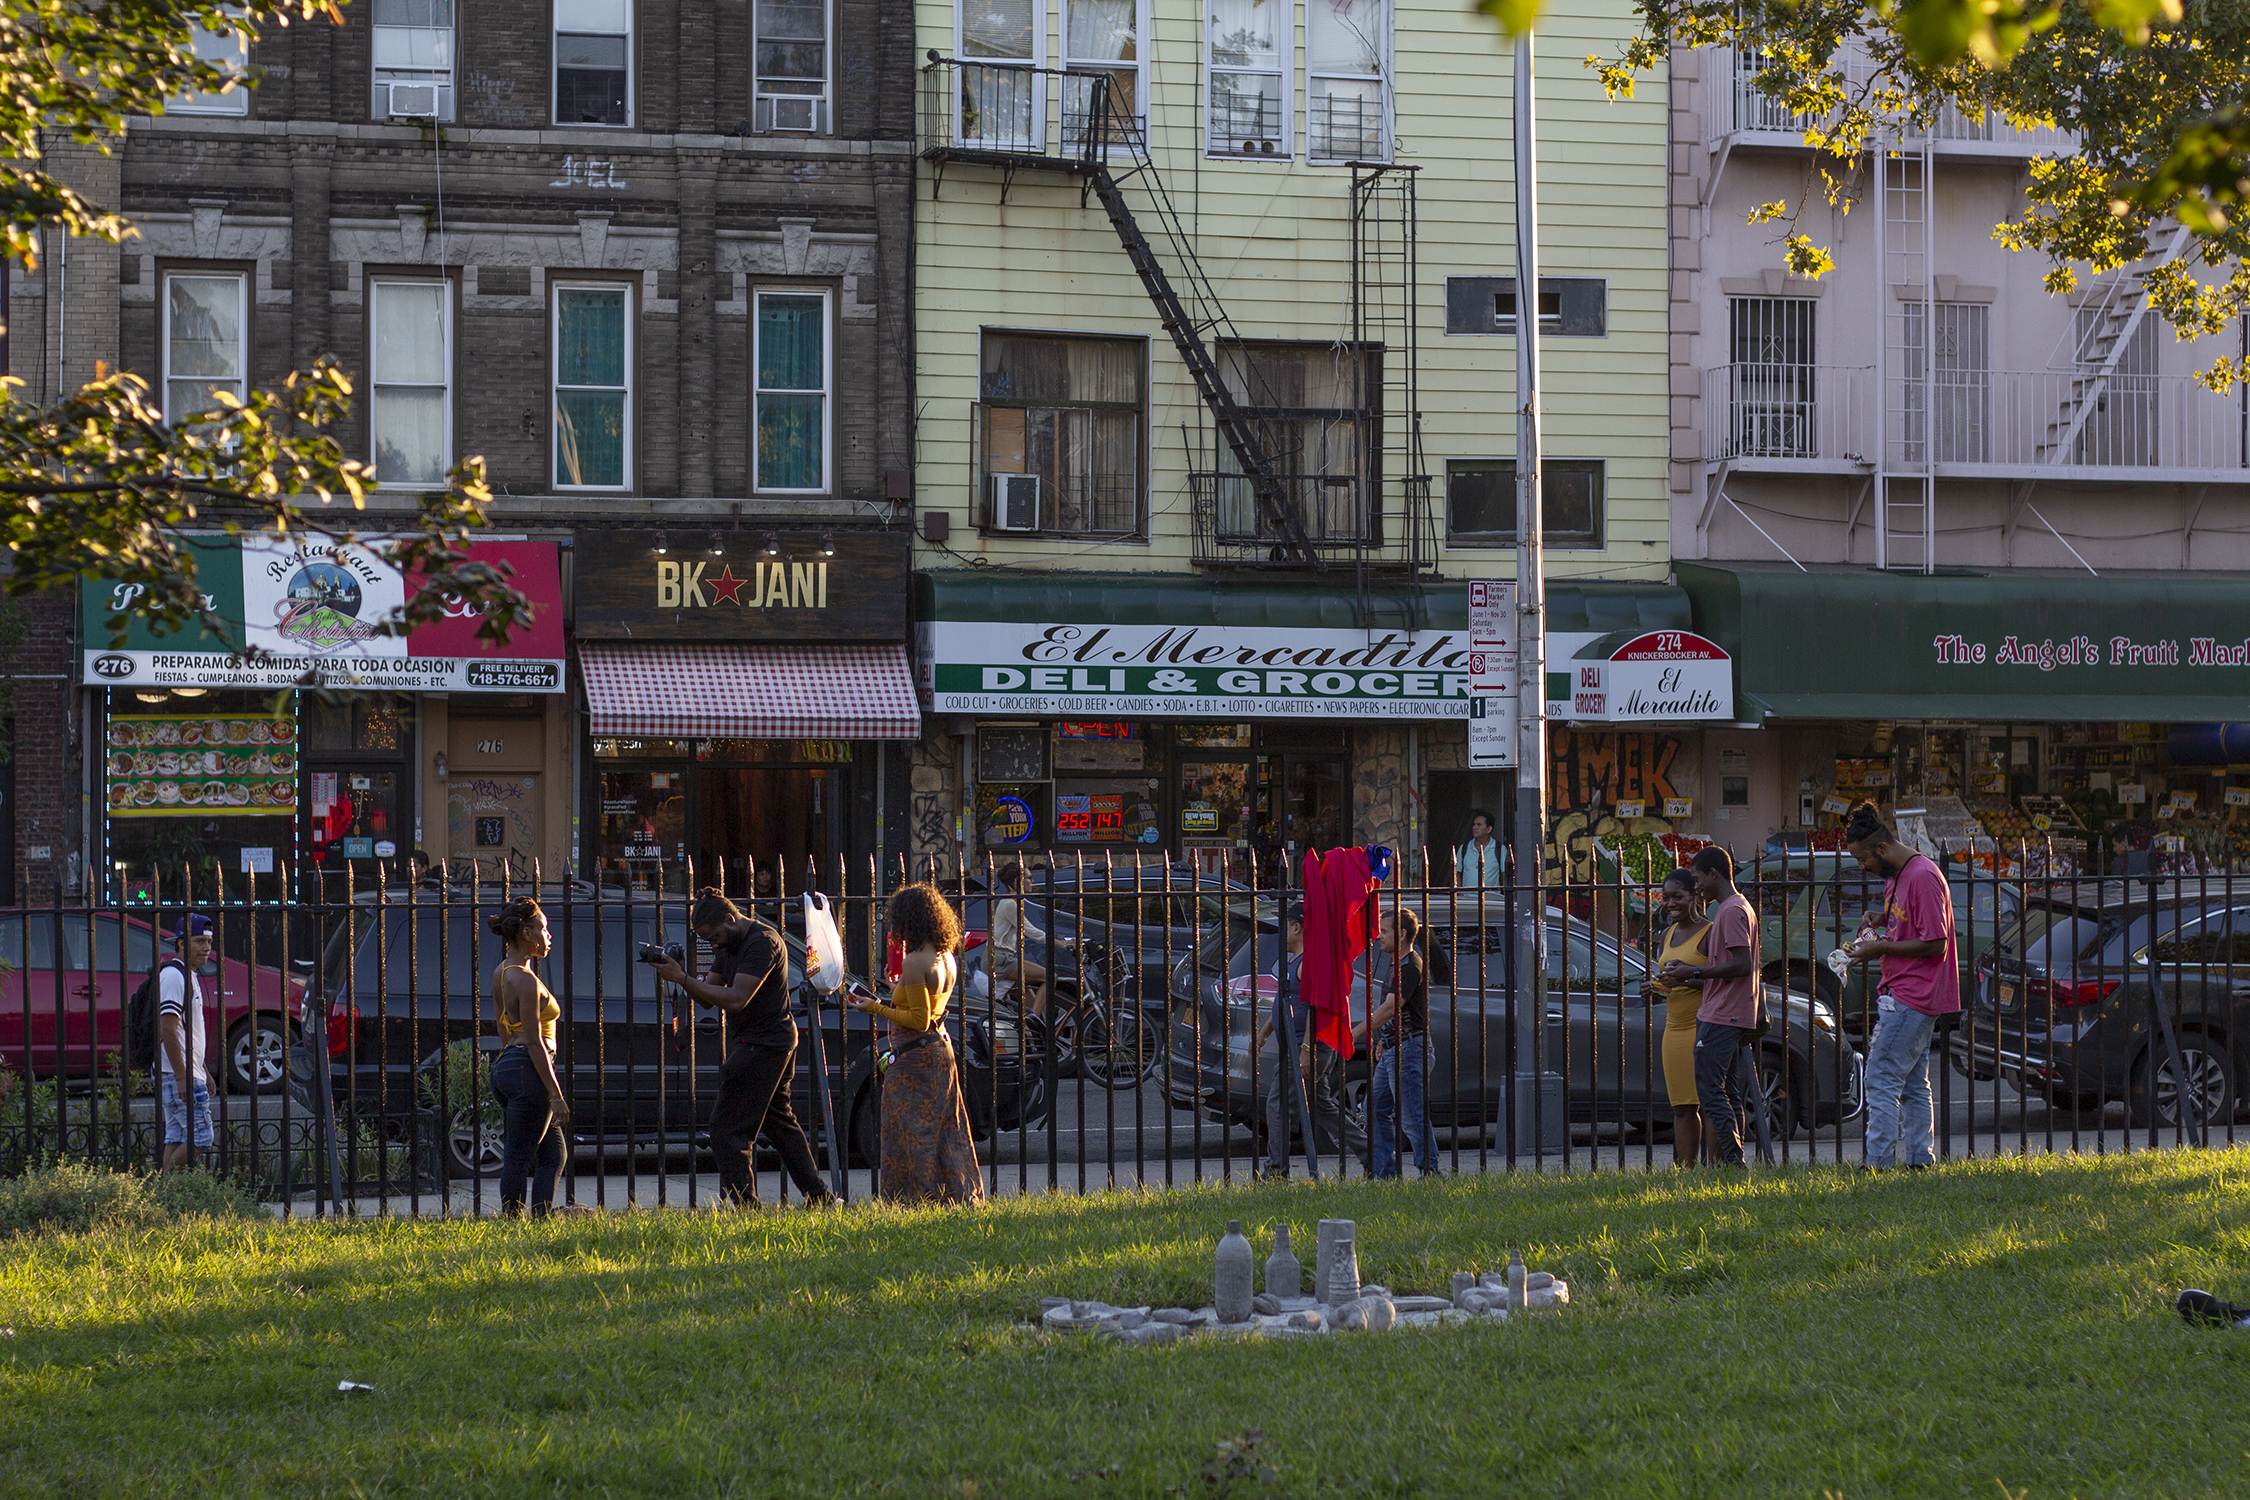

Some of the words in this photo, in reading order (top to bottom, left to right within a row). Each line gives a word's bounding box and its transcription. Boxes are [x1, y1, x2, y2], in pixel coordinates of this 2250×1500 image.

[549, 155, 627, 190] JOEL
[657, 560, 708, 608] BK
[748, 561, 828, 608] JANI
[1488, 585, 1508, 593] Farmers
[1488, 593, 1505, 601] Market
[1488, 601, 1499, 609] Only
[1472, 610, 1484, 618] June
[1490, 610, 1499, 618] Nov
[1500, 610, 1507, 618] 30
[1472, 619, 1493, 628] Saturday
[1486, 628, 1497, 636] 5pm
[1022, 625, 1114, 663] El
[1657, 633, 1682, 651] 274
[1628, 651, 1697, 660] KNICKERBOCKER
[1698, 650, 1711, 659] AV.
[1934, 635, 1986, 664] The
[1995, 635, 2099, 671] Angel's
[2109, 636, 2179, 665] Fruit
[98, 659, 131, 673] 276
[152, 655, 243, 670] PREPARAMOS
[247, 656, 309, 671] COMIDAS
[314, 658, 348, 672] PARA
[351, 659, 389, 673] TODA
[480, 663, 502, 673] FREE
[504, 664, 546, 674] DELIVERY
[1487, 665, 1500, 673] Except
[1500, 665, 1516, 673] Sunday
[155, 672, 188, 683] FIESTAS
[197, 672, 258, 684] CUMPLEANOS
[267, 673, 298, 684] BODAS
[313, 674, 350, 686] AUTIZOS
[360, 676, 421, 687] COMUNIONES
[430, 677, 448, 687] ETC.
[470, 673, 555, 686] 718-576-6671
[982, 667, 1126, 692] DELI
[1147, 669, 1198, 692] &
[1216, 670, 1469, 695] GROCER
[1581, 667, 1600, 688] DELI
[1658, 667, 1683, 693] El
[945, 697, 971, 709] COLD
[972, 697, 990, 709] CUT
[999, 697, 1048, 710] GROCERIES
[1058, 698, 1084, 711] COLD
[1085, 698, 1107, 711] BEER
[1116, 698, 1154, 711] CANDIES
[1163, 699, 1187, 712] SODA
[1196, 700, 1219, 712] E.B.T.
[1229, 700, 1255, 712] LOTTO
[1265, 701, 1314, 713] CIGARETTES
[1323, 701, 1347, 714] NEWS
[1350, 702, 1379, 714] PAPERS
[1389, 702, 1441, 715] ELECTRONIC
[1475, 698, 1480, 717] 1
[1575, 693, 1606, 714] GROCERY
[1618, 689, 1723, 715] Mercadito
[1487, 708, 1505, 717] parking
[1472, 735, 1489, 743] Except
[1489, 734, 1507, 743] Sunday
[478, 740, 502, 752] 276
[1008, 804, 1023, 812] NEW
[1009, 812, 1027, 823] YORK
[1058, 813, 1089, 829] 252
[1096, 812, 1122, 828] 147
[1139, 811, 1156, 820] YORK
[995, 823, 1029, 838] TTERY
[349, 844, 367, 854] OPEN
[624, 846, 636, 857] BK
[644, 845, 661, 857] JANI
